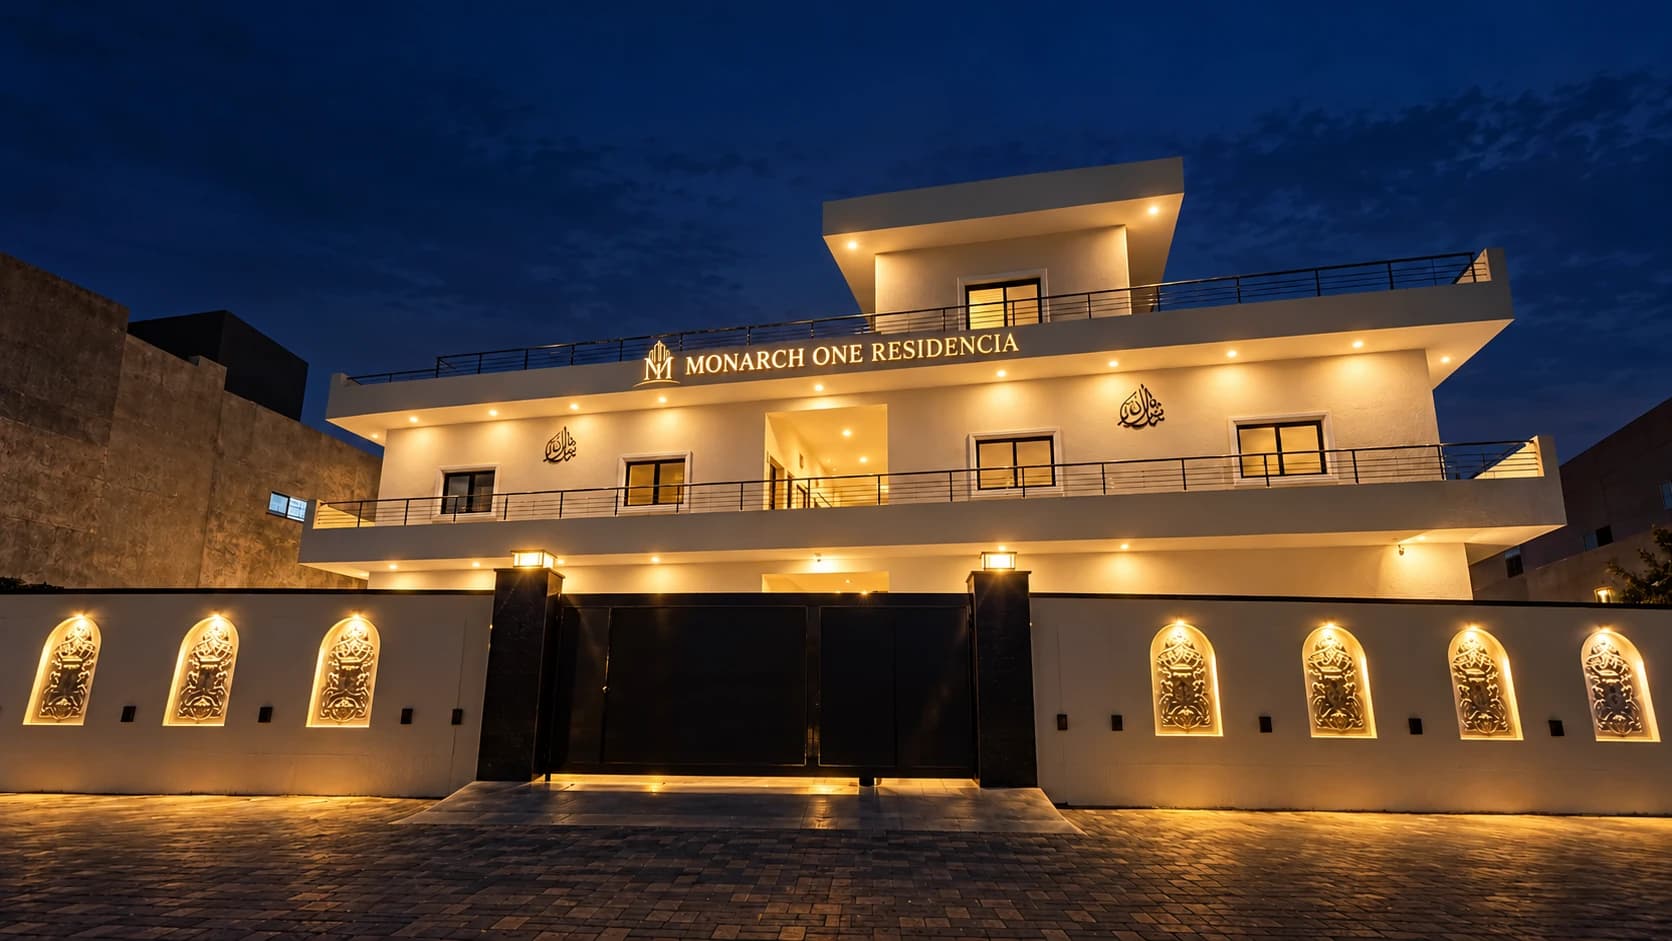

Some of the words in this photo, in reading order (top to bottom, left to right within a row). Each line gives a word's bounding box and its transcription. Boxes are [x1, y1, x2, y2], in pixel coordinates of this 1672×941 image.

[685, 347, 804, 376] MONARCH
[812, 344, 863, 366] ONE
[871, 332, 1019, 362] RESIDENCIA
